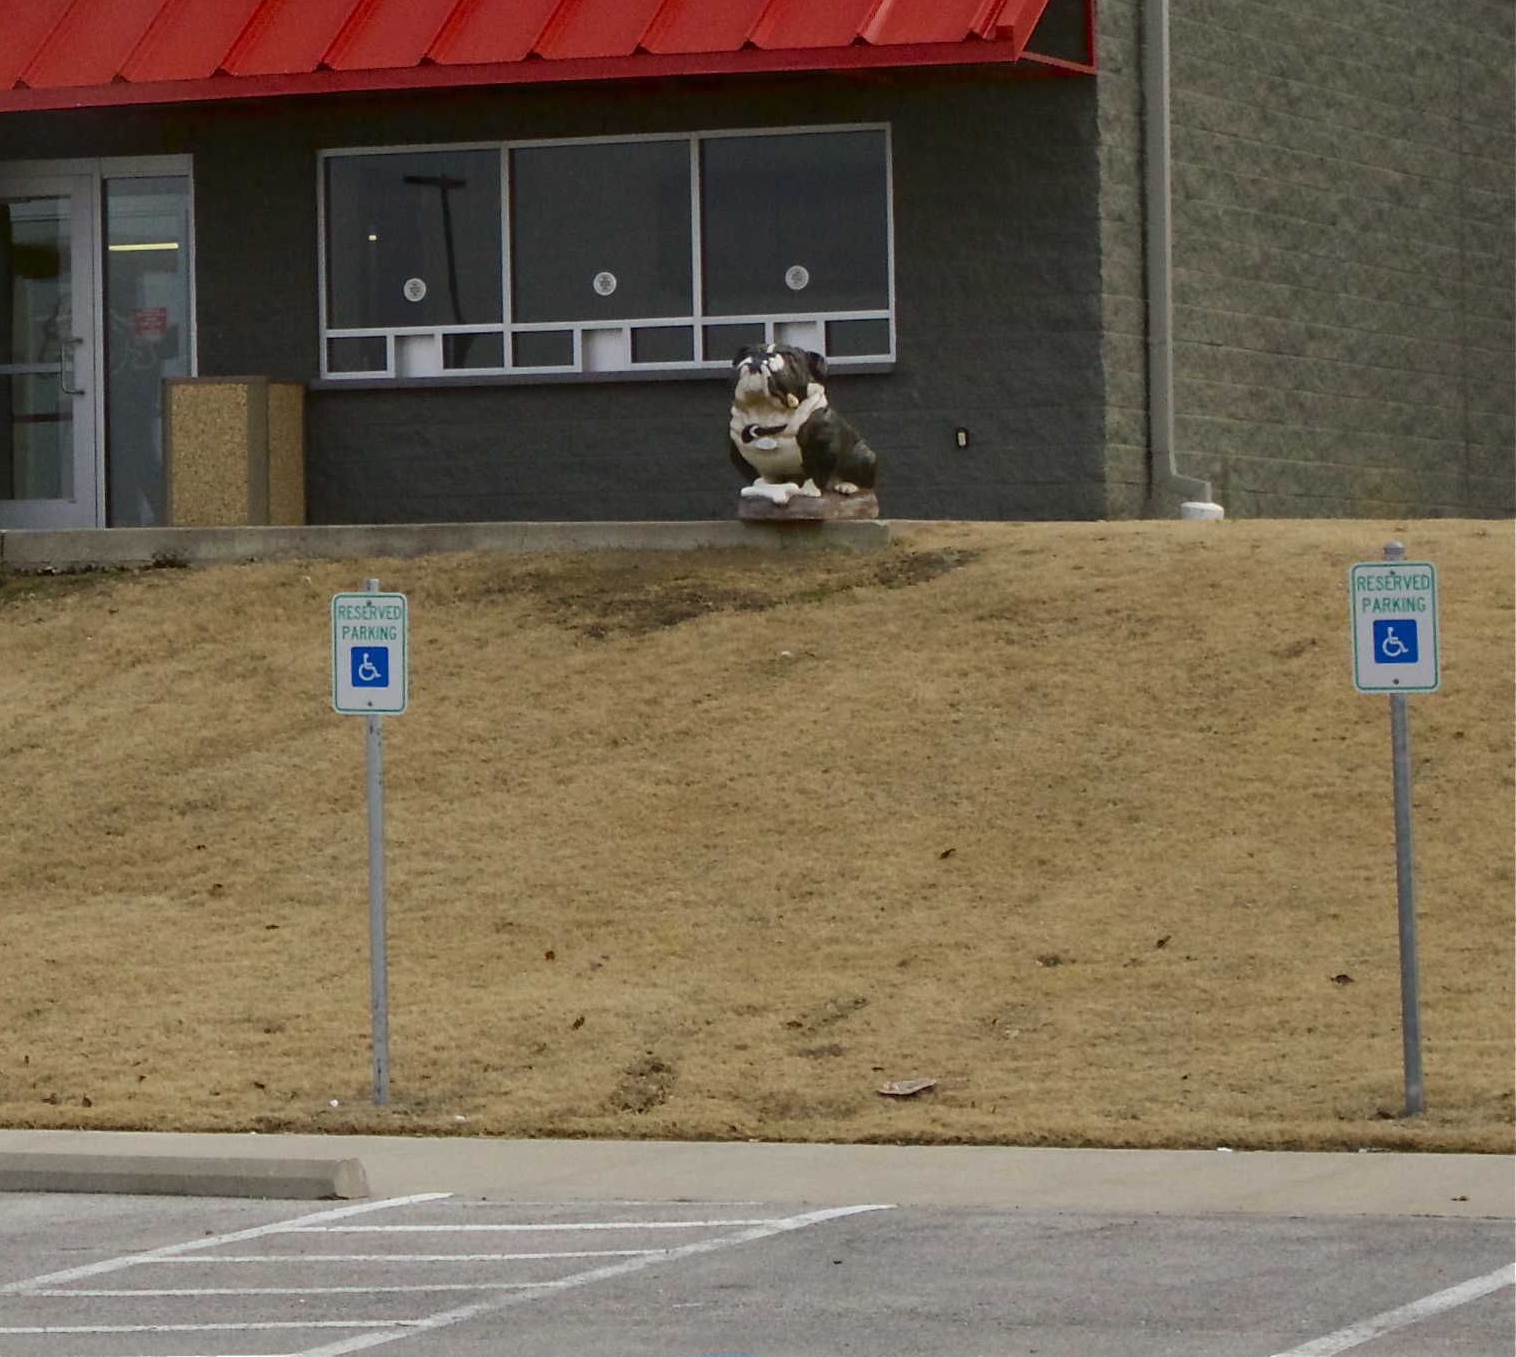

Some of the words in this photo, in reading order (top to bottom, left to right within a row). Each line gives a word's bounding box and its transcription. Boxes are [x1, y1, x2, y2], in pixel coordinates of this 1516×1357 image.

[1356, 575, 1430, 592] RESERVED
[338, 605, 402, 620] RESERVED
[1362, 597, 1427, 613] PARKING
[342, 626, 397, 640] PARKING
